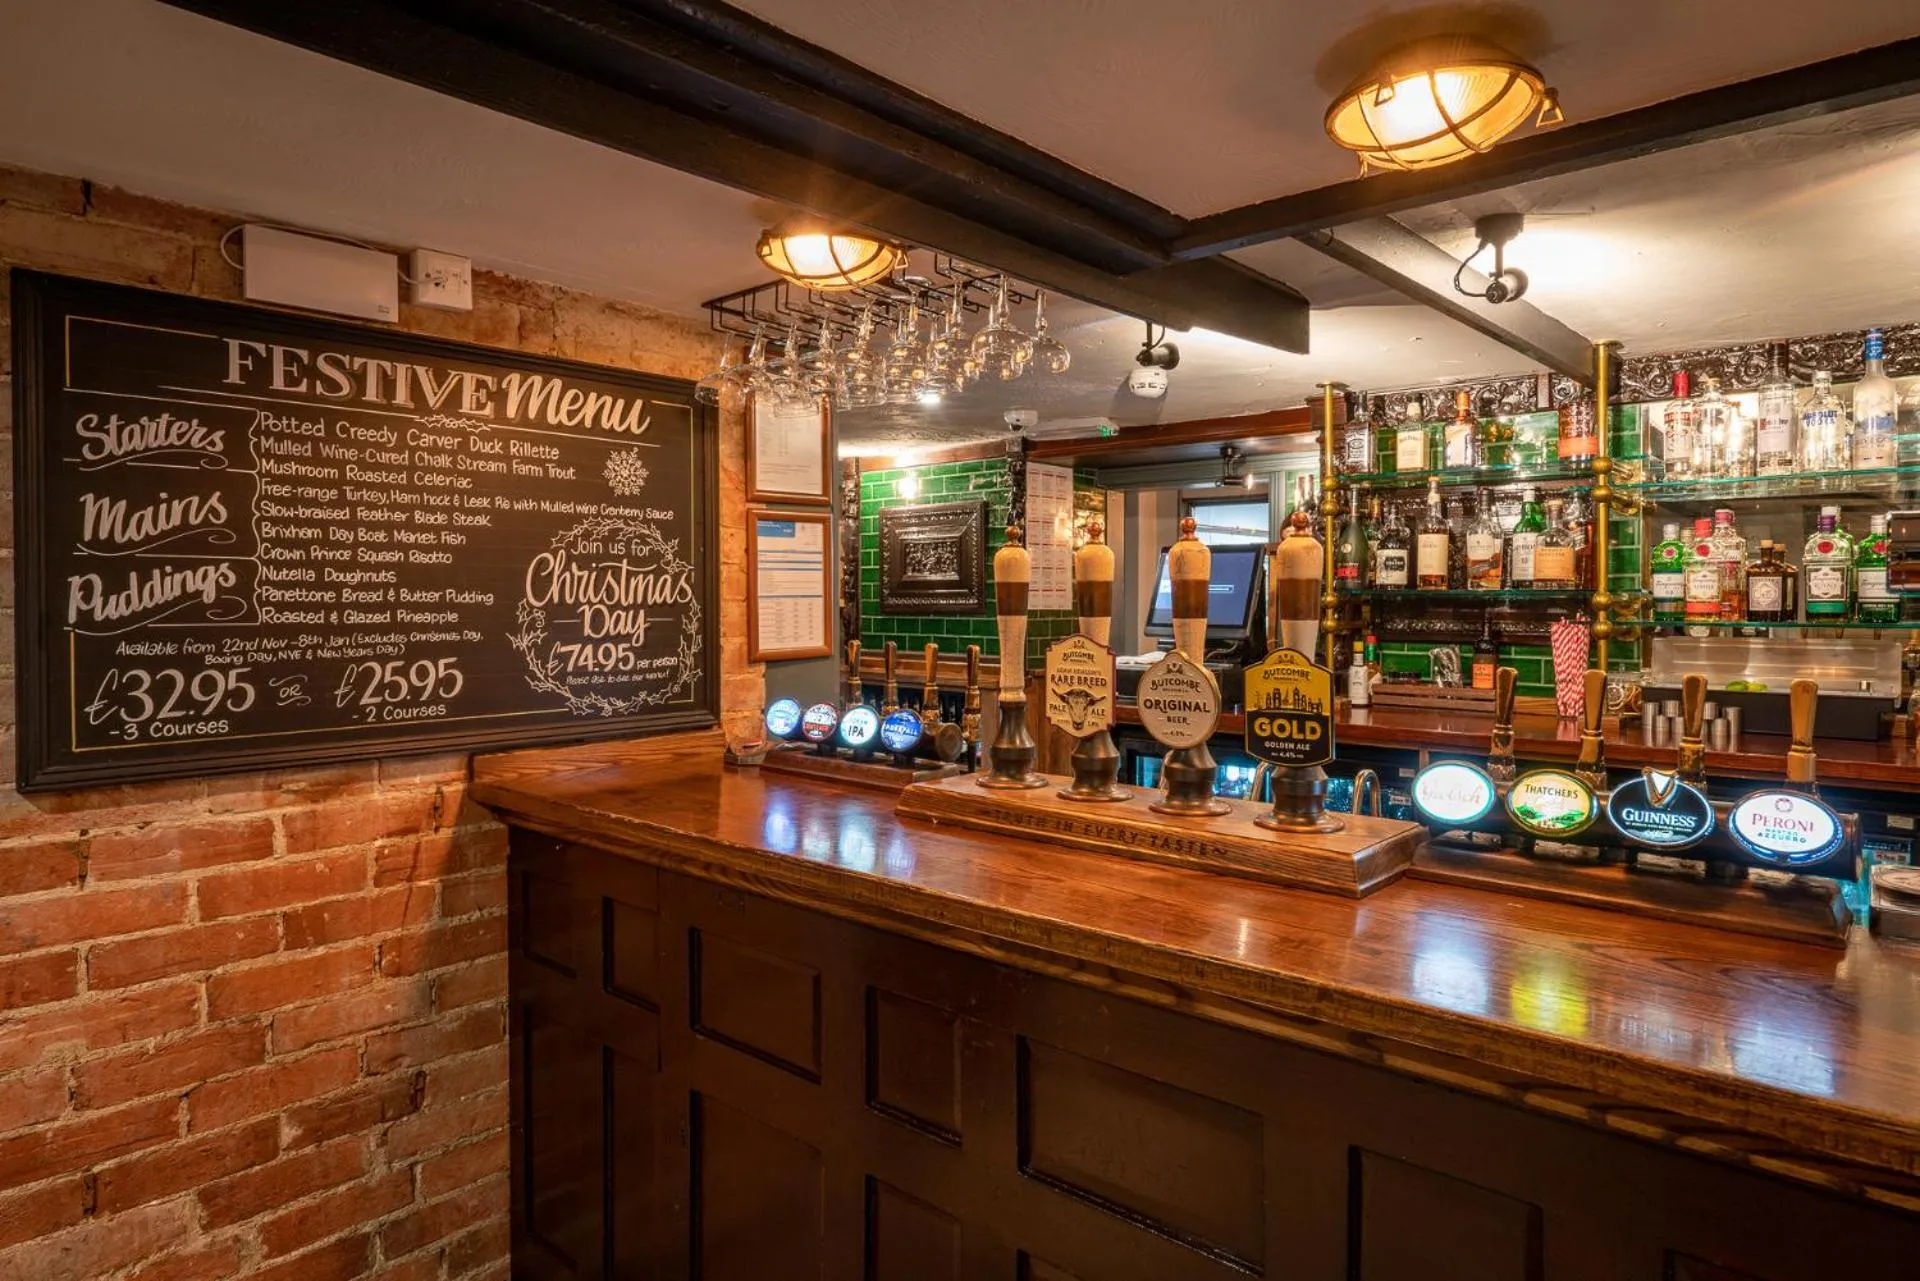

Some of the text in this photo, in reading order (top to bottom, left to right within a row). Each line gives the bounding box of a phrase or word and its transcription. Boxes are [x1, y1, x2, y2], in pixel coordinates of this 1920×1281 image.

[222, 338, 651, 435] FESTIVE Menu
[75, 413, 226, 460] Starters
[260, 411, 560, 460] Potted Creedy Carver Duck Rillette
[260, 436, 576, 480] Mulled Wine-Cured Chalk Stream Farm Trout
[260, 458, 473, 489] Mushroom Roasted Celeriac
[260, 478, 338, 501] Free-range
[464, 495, 491, 508] Leek
[495, 495, 510, 509] Pie
[513, 496, 538, 511] with
[540, 499, 574, 514] Mulled
[575, 503, 598, 515] wine
[600, 504, 643, 519] Cranberry
[646, 508, 674, 520] Sauce
[79, 491, 228, 543] Mains
[260, 500, 492, 527] Slow-braised Feather Blade Steak
[261, 521, 466, 545] Brixham Day Boat Market Fish
[260, 542, 453, 564] Crown Prince Squash Risotto
[571, 538, 652, 557] Join us for
[261, 566, 397, 585] Nutella Doughnuts
[525, 549, 692, 608] Christmas
[67, 562, 237, 624] Puddings
[261, 585, 336, 603] Panettone
[342, 588, 383, 603] Bread
[400, 588, 443, 603] Butter
[446, 589, 494, 606] Pudding
[261, 607, 325, 624] Roasted
[343, 609, 391, 624] Glazed
[397, 609, 459, 625] Pineapple
[576, 604, 651, 647] Day
[115, 640, 178, 656] Available
[183, 637, 215, 654] from
[222, 637, 258, 653] 22nd
[261, 637, 288, 650] Nov
[326, 634, 350, 648] Jan
[351, 631, 407, 646] (Excludes
[410, 631, 460, 642] Christmas
[204, 654, 243, 665] Boxing
[278, 650, 301, 660] NYE
[317, 647, 341, 658] New
[376, 645, 406, 656] Day)
[545, 641, 678, 676] £74.95 per person
[1062, 651, 1096, 664] BUTCOMBE
[334, 657, 463, 707] £25.95
[1050, 674, 1107, 688] RARE BREED
[1262, 668, 1311, 681] BUTCOMBE
[84, 667, 256, 725] £32.95
[280, 684, 302, 698] OR
[1150, 678, 1201, 693] BUTCOMBE
[365, 706, 377, 722] 2
[383, 704, 446, 720] Courses
[1049, 703, 1106, 717] PALE ALE
[1143, 698, 1211, 714] ORIGINAL
[150, 720, 229, 738] Courses
[1166, 716, 1191, 725] BEER
[1253, 717, 1322, 741] GOLD
[847, 725, 865, 738] IPA
[1264, 741, 1310, 751] GOLDEN ALE
[1524, 783, 1579, 800] THATCHERS
[1622, 807, 1698, 828] GUINNESS
[1751, 813, 1814, 832] PERONI
[1083, 824, 1138, 844] EVERY
[1150, 834, 1208, 856] TASTE
[1757, 832, 1807, 843] AZZURRO
